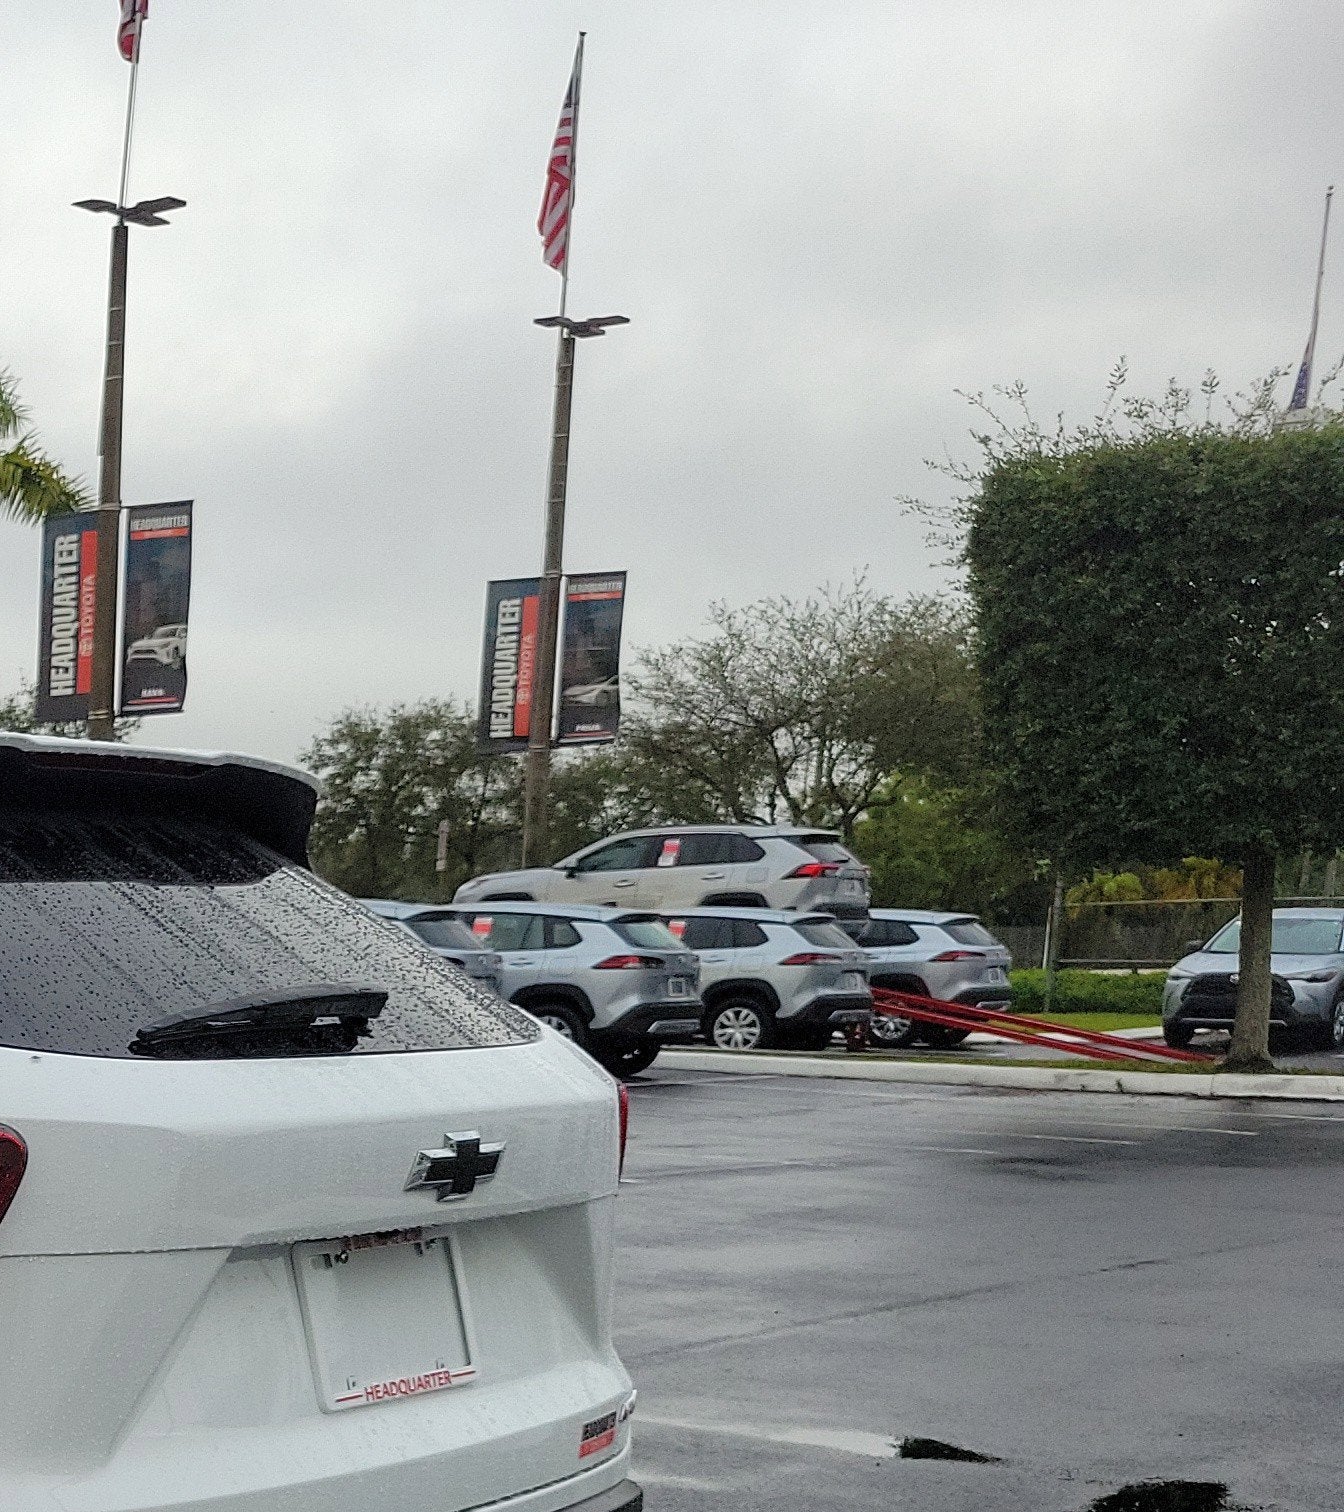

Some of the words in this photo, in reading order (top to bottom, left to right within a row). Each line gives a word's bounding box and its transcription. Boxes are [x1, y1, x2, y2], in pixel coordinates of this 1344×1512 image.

[49, 532, 81, 698] HEADQUARTER
[489, 598, 522, 739] HEADQUARTER
[364, 1370, 452, 1402] HEADQUARTER
